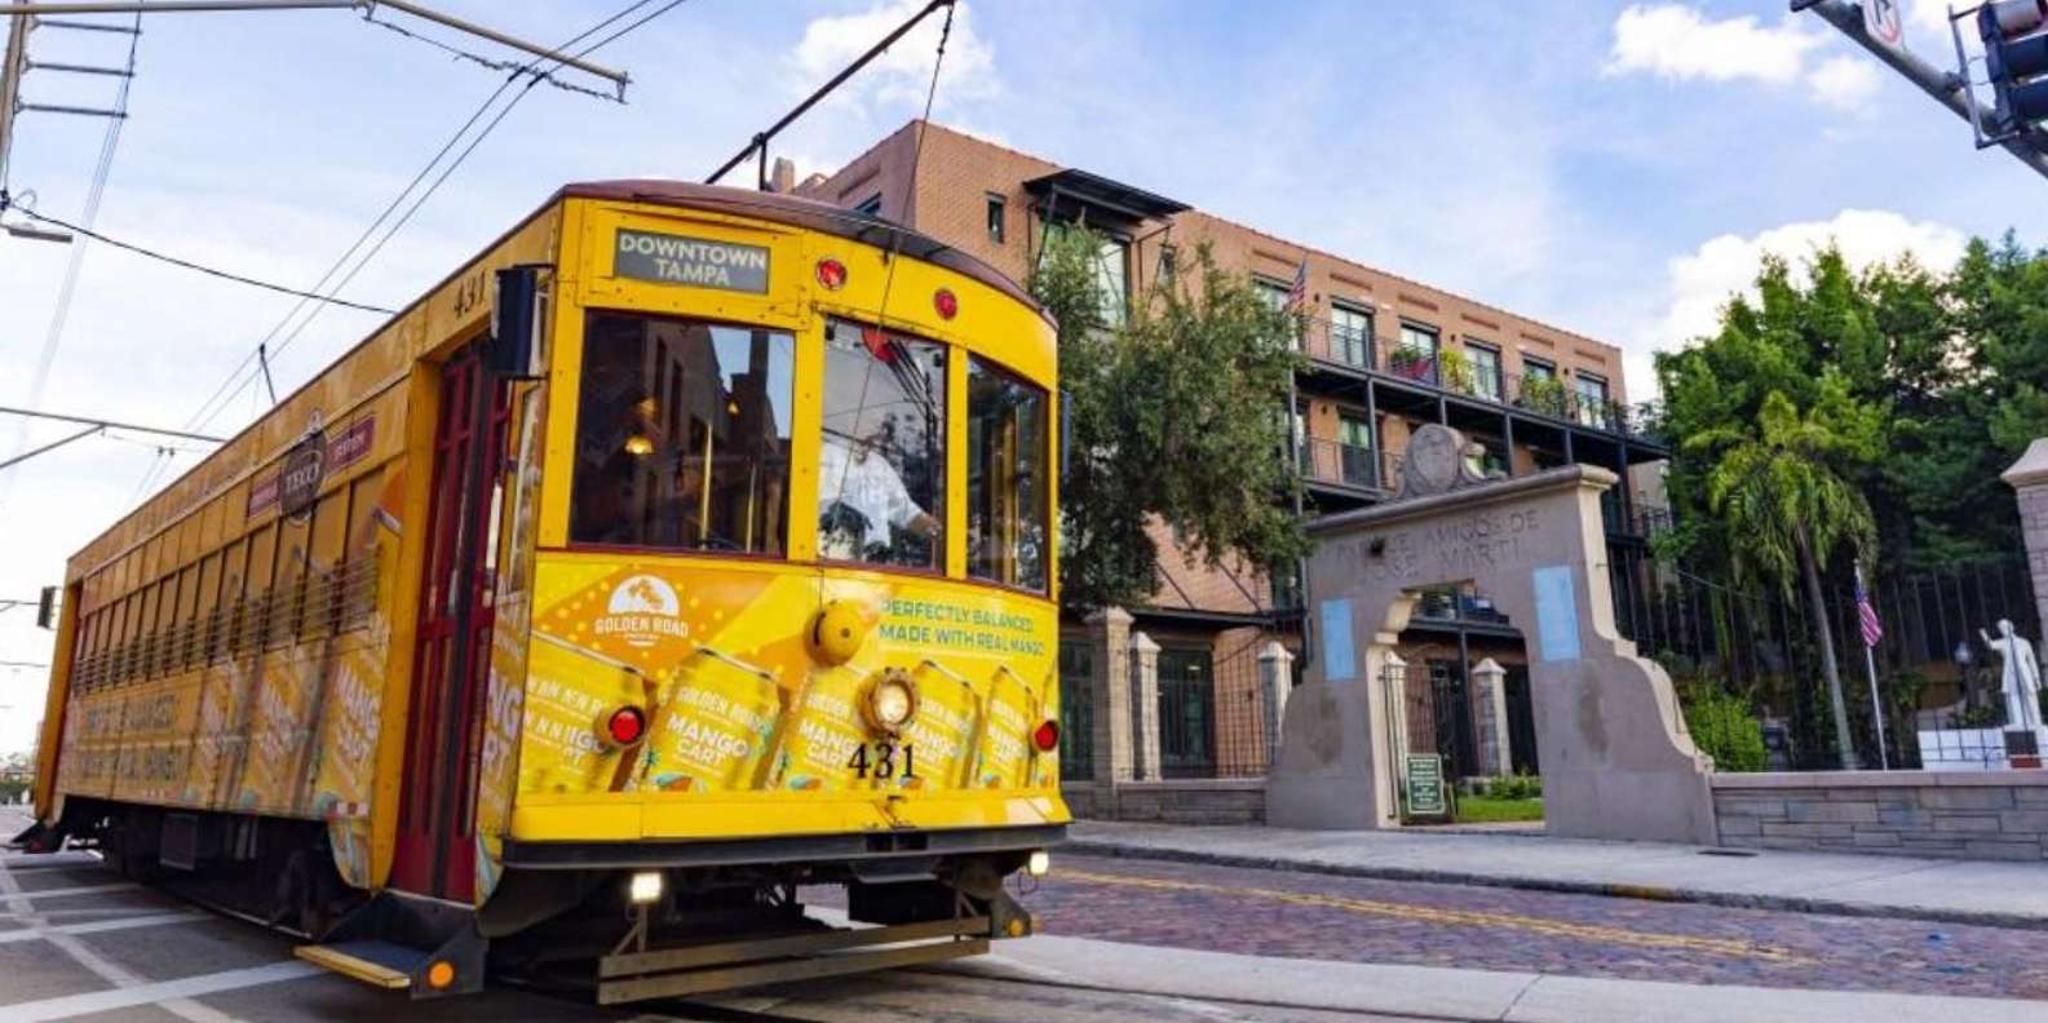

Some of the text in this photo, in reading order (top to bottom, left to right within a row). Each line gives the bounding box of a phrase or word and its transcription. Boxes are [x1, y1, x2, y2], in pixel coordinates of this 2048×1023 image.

[620, 234, 767, 270] DOWNTOWN
[654, 258, 731, 286] TAMPA
[453, 270, 487, 319] 431
[1509, 509, 1540, 534] DE
[879, 600, 969, 623] PERFECTLY
[594, 616, 650, 635] GOLDEN
[652, 617, 689, 638] ROAD
[879, 623, 931, 643] MADE
[936, 628, 975, 647] WITH
[976, 632, 1009, 651] REAL
[666, 711, 750, 758] MANGO
[677, 738, 728, 766] CART
[847, 743, 917, 779] 431
